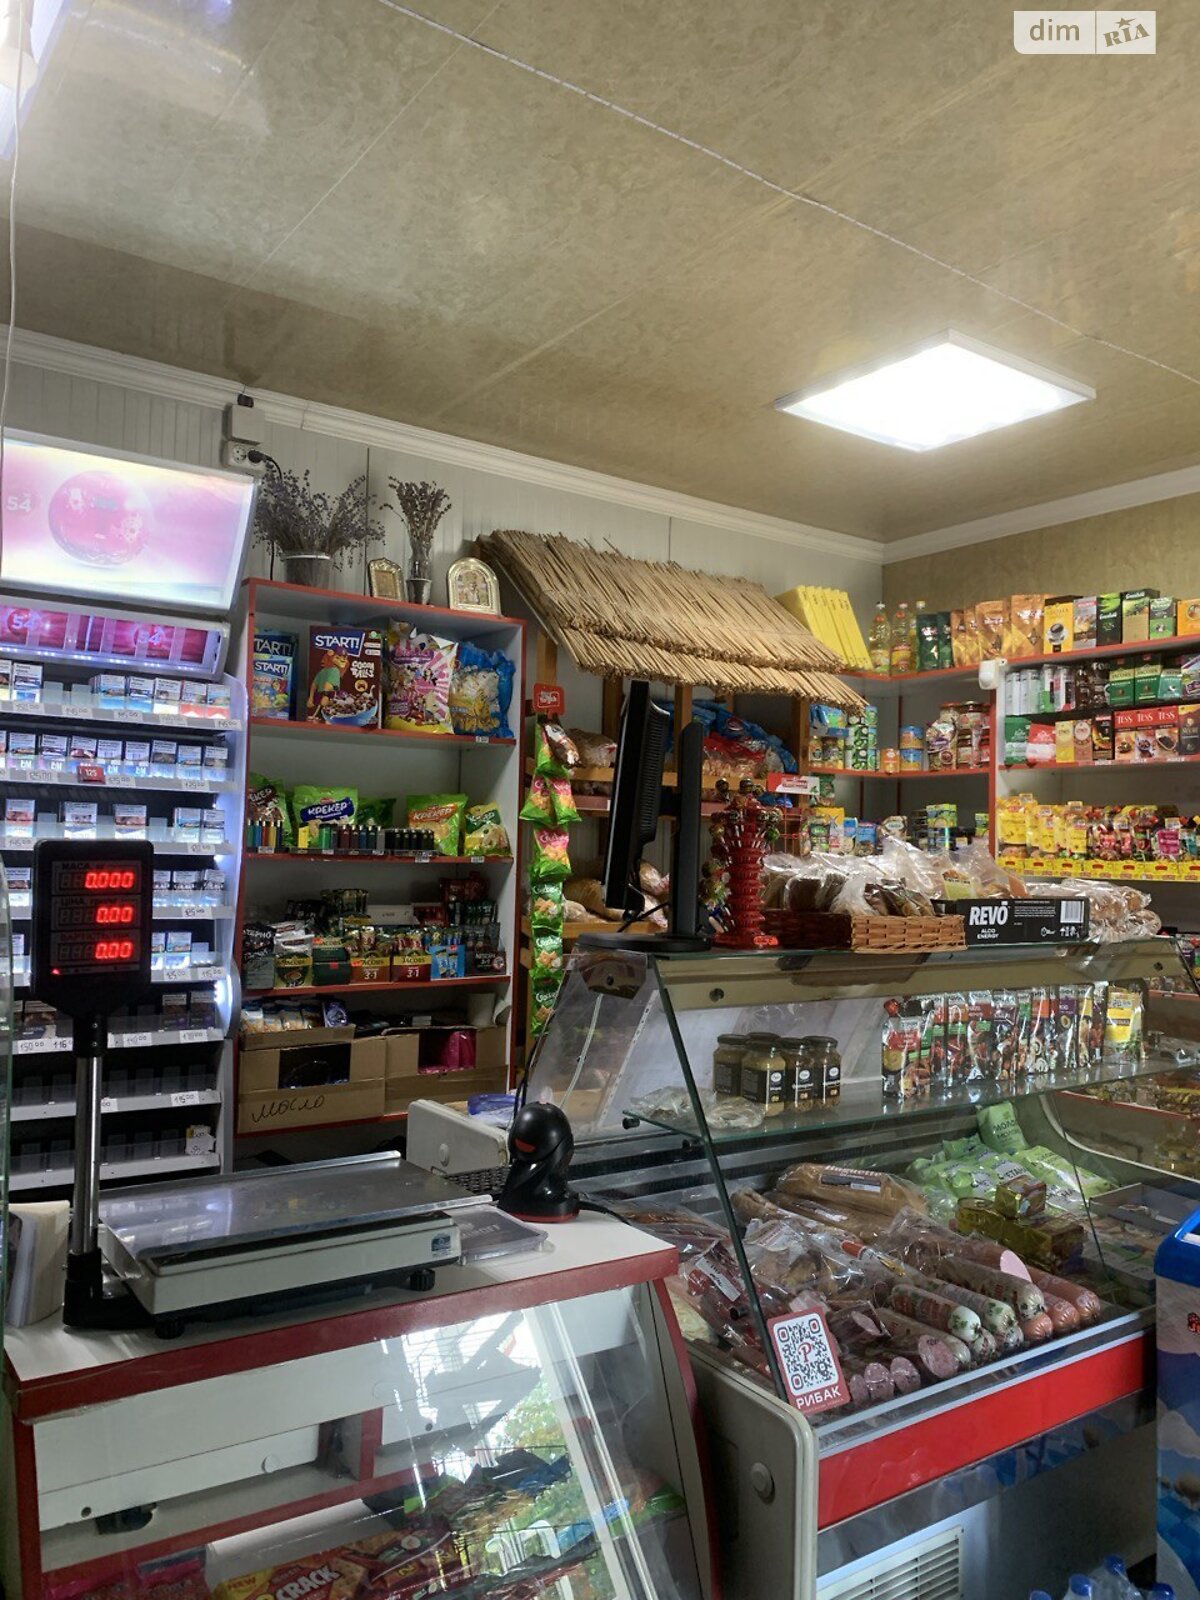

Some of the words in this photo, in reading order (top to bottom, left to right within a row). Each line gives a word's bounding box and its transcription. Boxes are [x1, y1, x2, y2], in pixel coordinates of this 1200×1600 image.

[315, 635, 360, 649] START!
[255, 661, 289, 675] START!
[307, 801, 348, 816] КРЕКЕР
[84, 872, 135, 889] 0.000
[95, 907, 134, 923] 0.00
[94, 942, 133, 960] 0.00
[795, 1385, 842, 1409] РИБАК
[227, 1577, 256, 1590] NEW
[276, 1565, 342, 1600] CRACK
